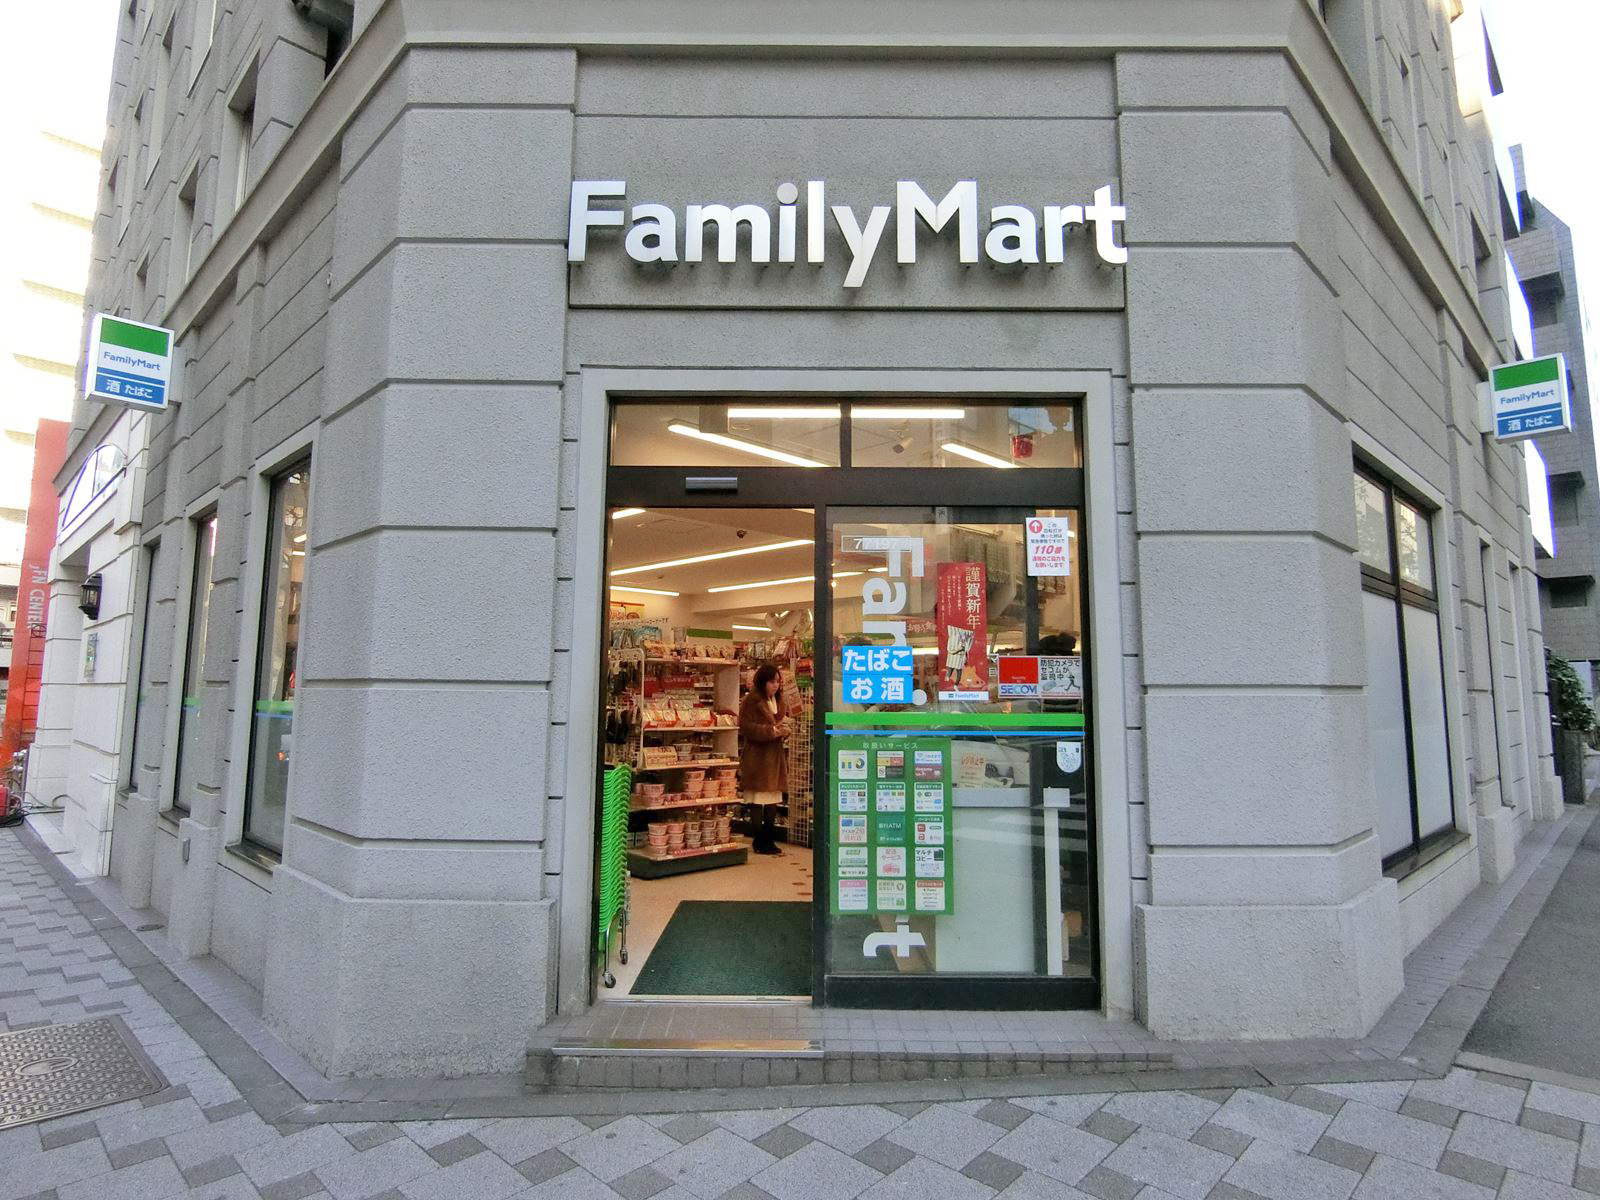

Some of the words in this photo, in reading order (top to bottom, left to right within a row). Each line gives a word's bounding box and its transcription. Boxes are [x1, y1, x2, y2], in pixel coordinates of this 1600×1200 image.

[567, 180, 1128, 288] FamilyMart
[103, 351, 161, 371] FamilyMart
[106, 379, 121, 393] 酒
[124, 384, 153, 399] たばこ
[1500, 389, 1555, 405] FamilyMart
[1507, 419, 1521, 432] 酒
[1525, 415, 1553, 428] たばこ
[965, 566, 981, 630] 謹賀新年
[844, 648, 912, 672] たばこ
[850, 677, 905, 701] お酒
[1001, 685, 1037, 694] SECOM
